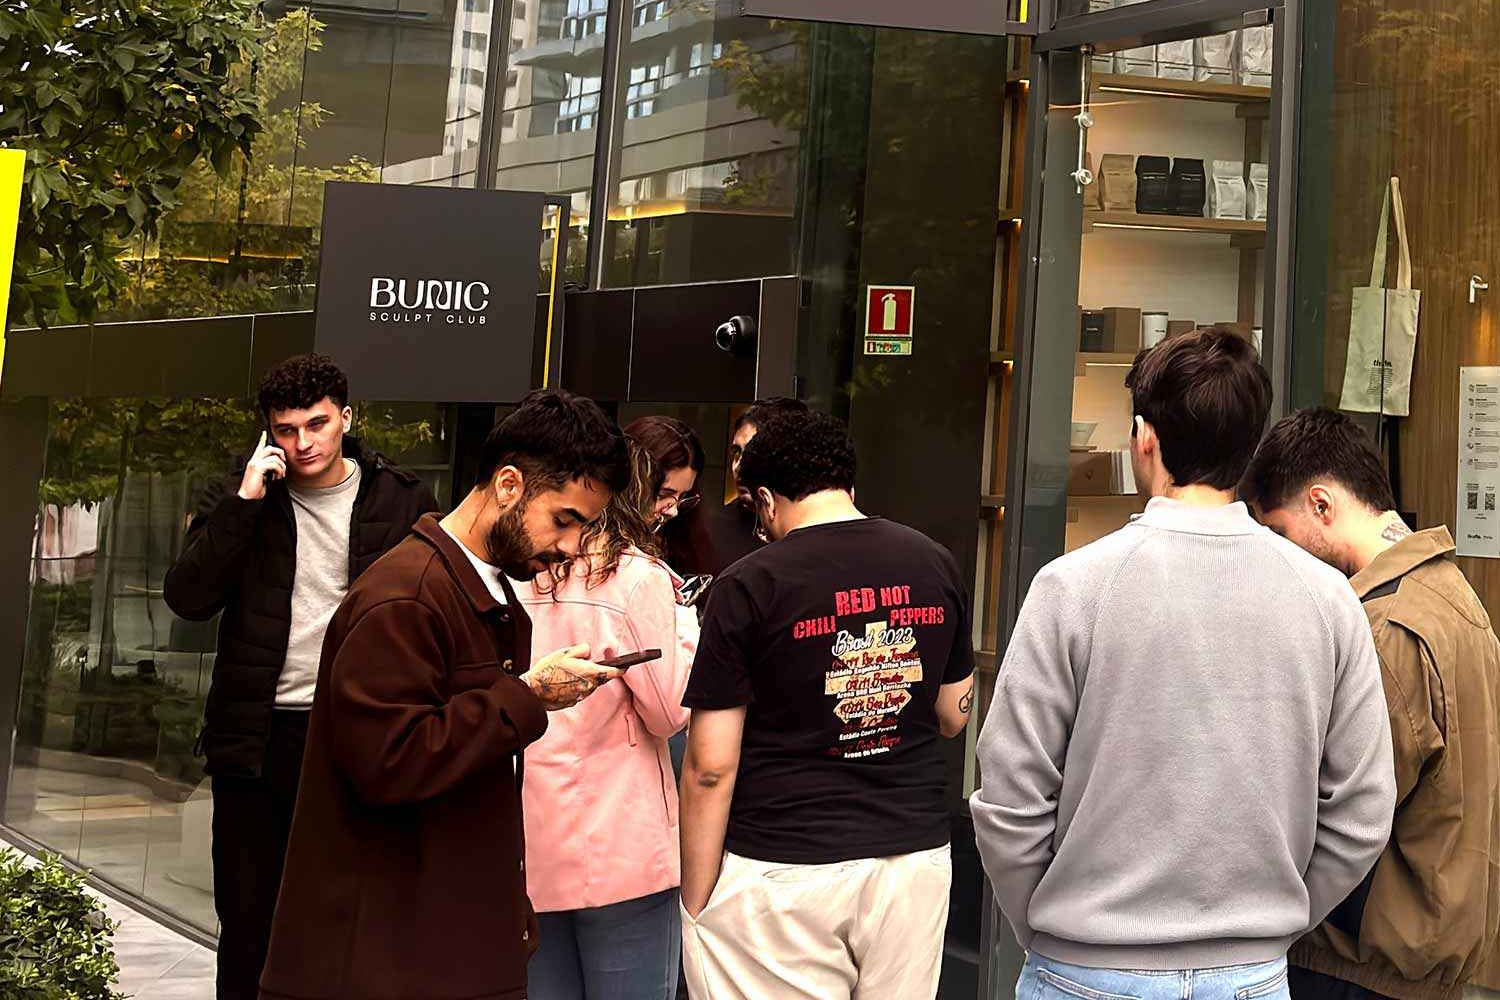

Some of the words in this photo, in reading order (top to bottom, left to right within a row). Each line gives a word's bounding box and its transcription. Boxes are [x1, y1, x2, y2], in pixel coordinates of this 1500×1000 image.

[370, 277, 490, 312] BUNIC
[369, 311, 433, 323] SCULPT
[446, 314, 487, 325] CLUB
[835, 587, 877, 617] RED
[879, 585, 911, 607] HOT
[792, 615, 837, 640] CHILI
[889, 606, 945, 628] PEPPERS
[878, 626, 914, 648] 2023
